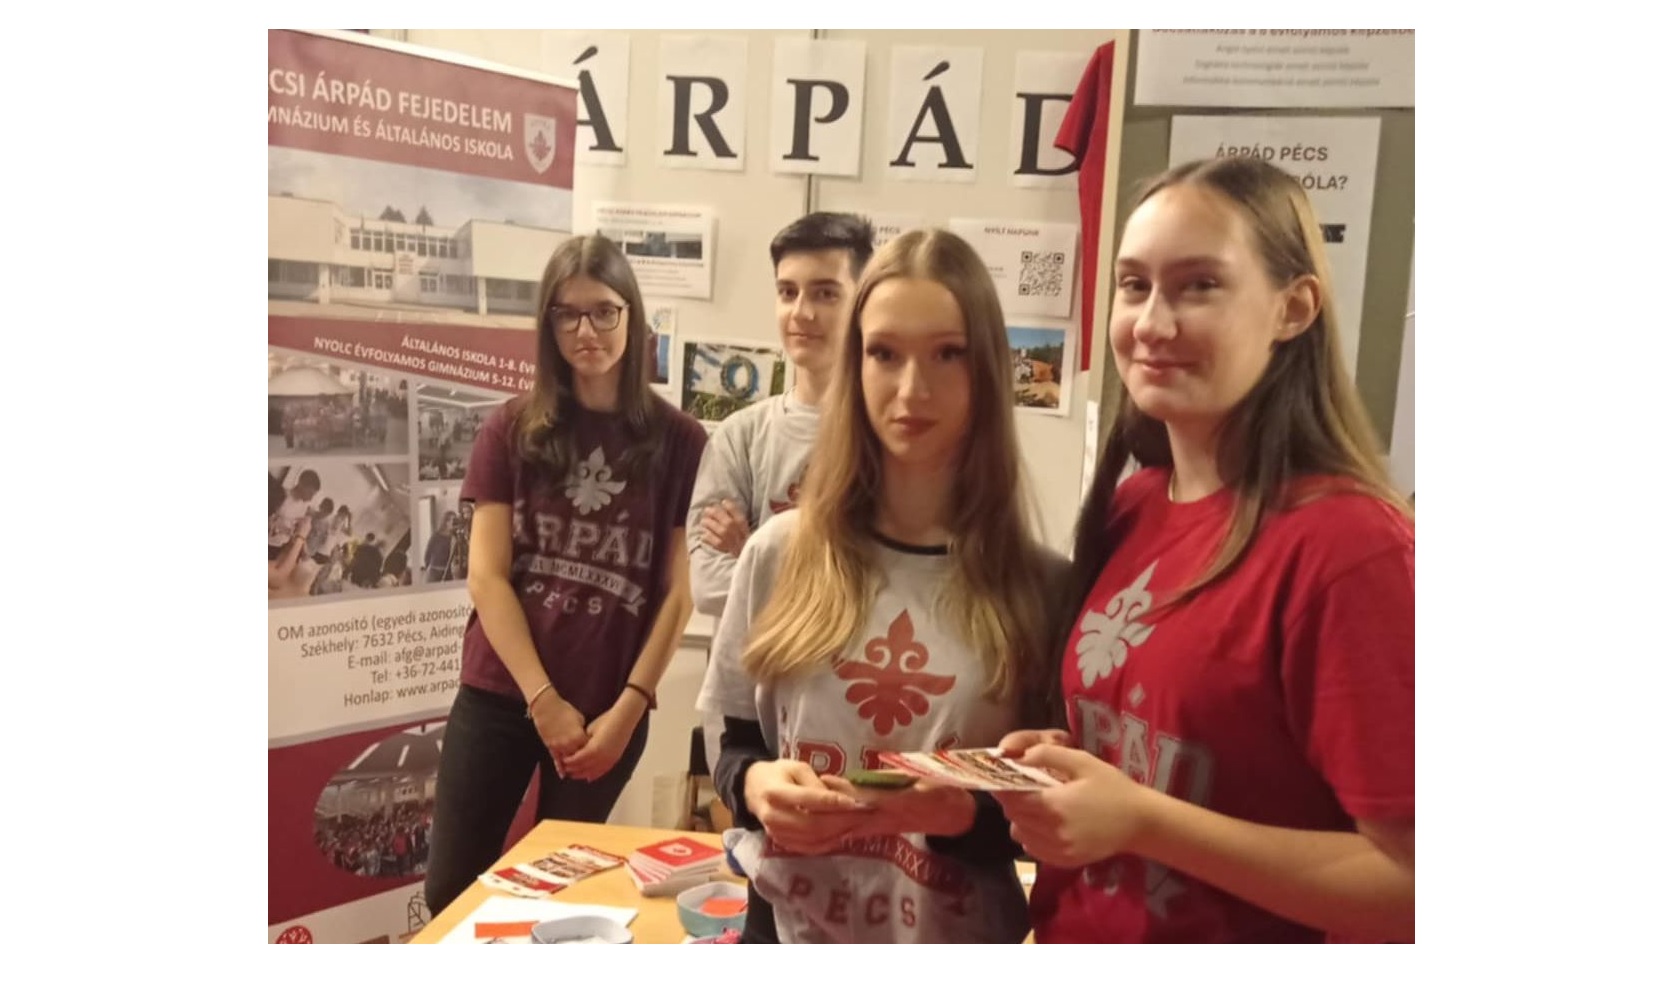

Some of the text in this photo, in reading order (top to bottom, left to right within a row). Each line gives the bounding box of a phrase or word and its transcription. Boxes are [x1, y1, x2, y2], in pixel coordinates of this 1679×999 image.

[269, 69, 512, 134] CSI ÁRPÁD FEJEDELEM
[353, 115, 371, 138] ÉS
[375, 118, 461, 152] ÁLTALÁNOS
[464, 141, 513, 160] ISKOLA
[1280, 143, 1328, 161] PÉCS
[1297, 172, 1349, 190] ÓLA?
[314, 336, 351, 355] NYOLC
[354, 342, 426, 369] ÉVFOLYAMOS
[428, 360, 490, 383] GIMNÁZIUM
[491, 373, 517, 388] 5-12.
[401, 334, 460, 359] ÁLTALÁNOS
[462, 348, 496, 367] ISKOLA
[498, 357, 517, 372] 1-8.
[526, 581, 603, 615] PÉCS
[277, 625, 304, 641] OM
[308, 615, 368, 638] azonosító
[372, 612, 416, 632] (egyedi
[301, 638, 358, 658] Székhely:
[363, 633, 393, 648] 7632
[397, 631, 427, 644] Pécs,
[347, 654, 389, 669] E-mail:
[344, 688, 393, 707] Honlap:
[787, 872, 917, 929] PÉCS
